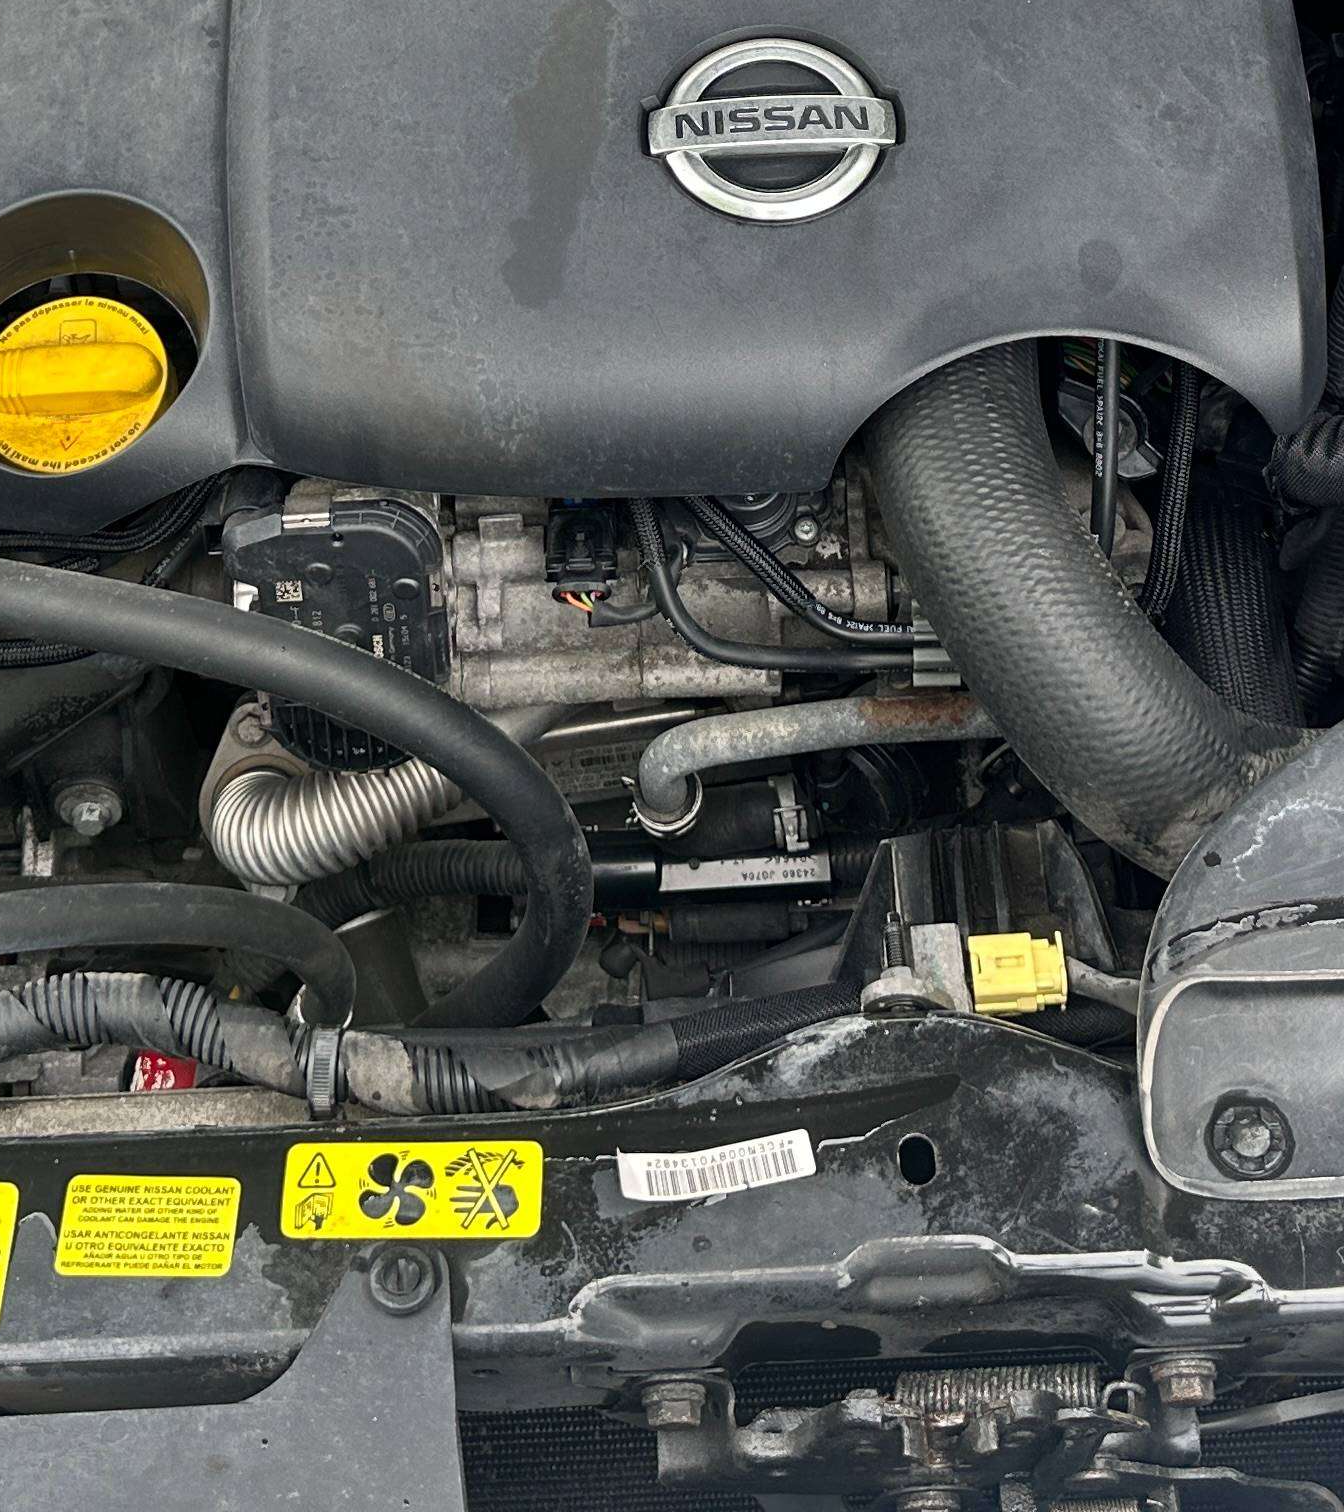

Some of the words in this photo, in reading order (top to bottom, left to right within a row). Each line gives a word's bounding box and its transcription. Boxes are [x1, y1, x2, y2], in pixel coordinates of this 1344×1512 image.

[674, 104, 870, 139] NISSAN
[13, 315, 32, 332] pas
[84, 298, 95, 307] le
[97, 301, 129, 318] niveau
[129, 315, 150, 336] maxi
[12, 451, 39, 467] maxi
[41, 458, 61, 471] the
[65, 448, 108, 470] exceed
[71, 1185, 92, 1193] USE
[95, 1185, 141, 1194] GENUINE
[143, 1186, 182, 1194] NISSAN
[185, 1186, 235, 1195] COOLANT
[72, 1196, 87, 1204] OR
[90, 1196, 126, 1205] OTHER
[128, 1197, 163, 1205] EXACT
[166, 1197, 232, 1206] EQUIVALENT
[63, 1230, 91, 1238] USAR
[94, 1231, 189, 1240] ANTICONGELANTE
[192, 1232, 231, 1240] NISSAN
[65, 1242, 73, 1250] U
[75, 1242, 105, 1250] OTRO
[108, 1243, 179, 1251] EQUIVALENTE
[182, 1244, 225, 1252] EXACTO
